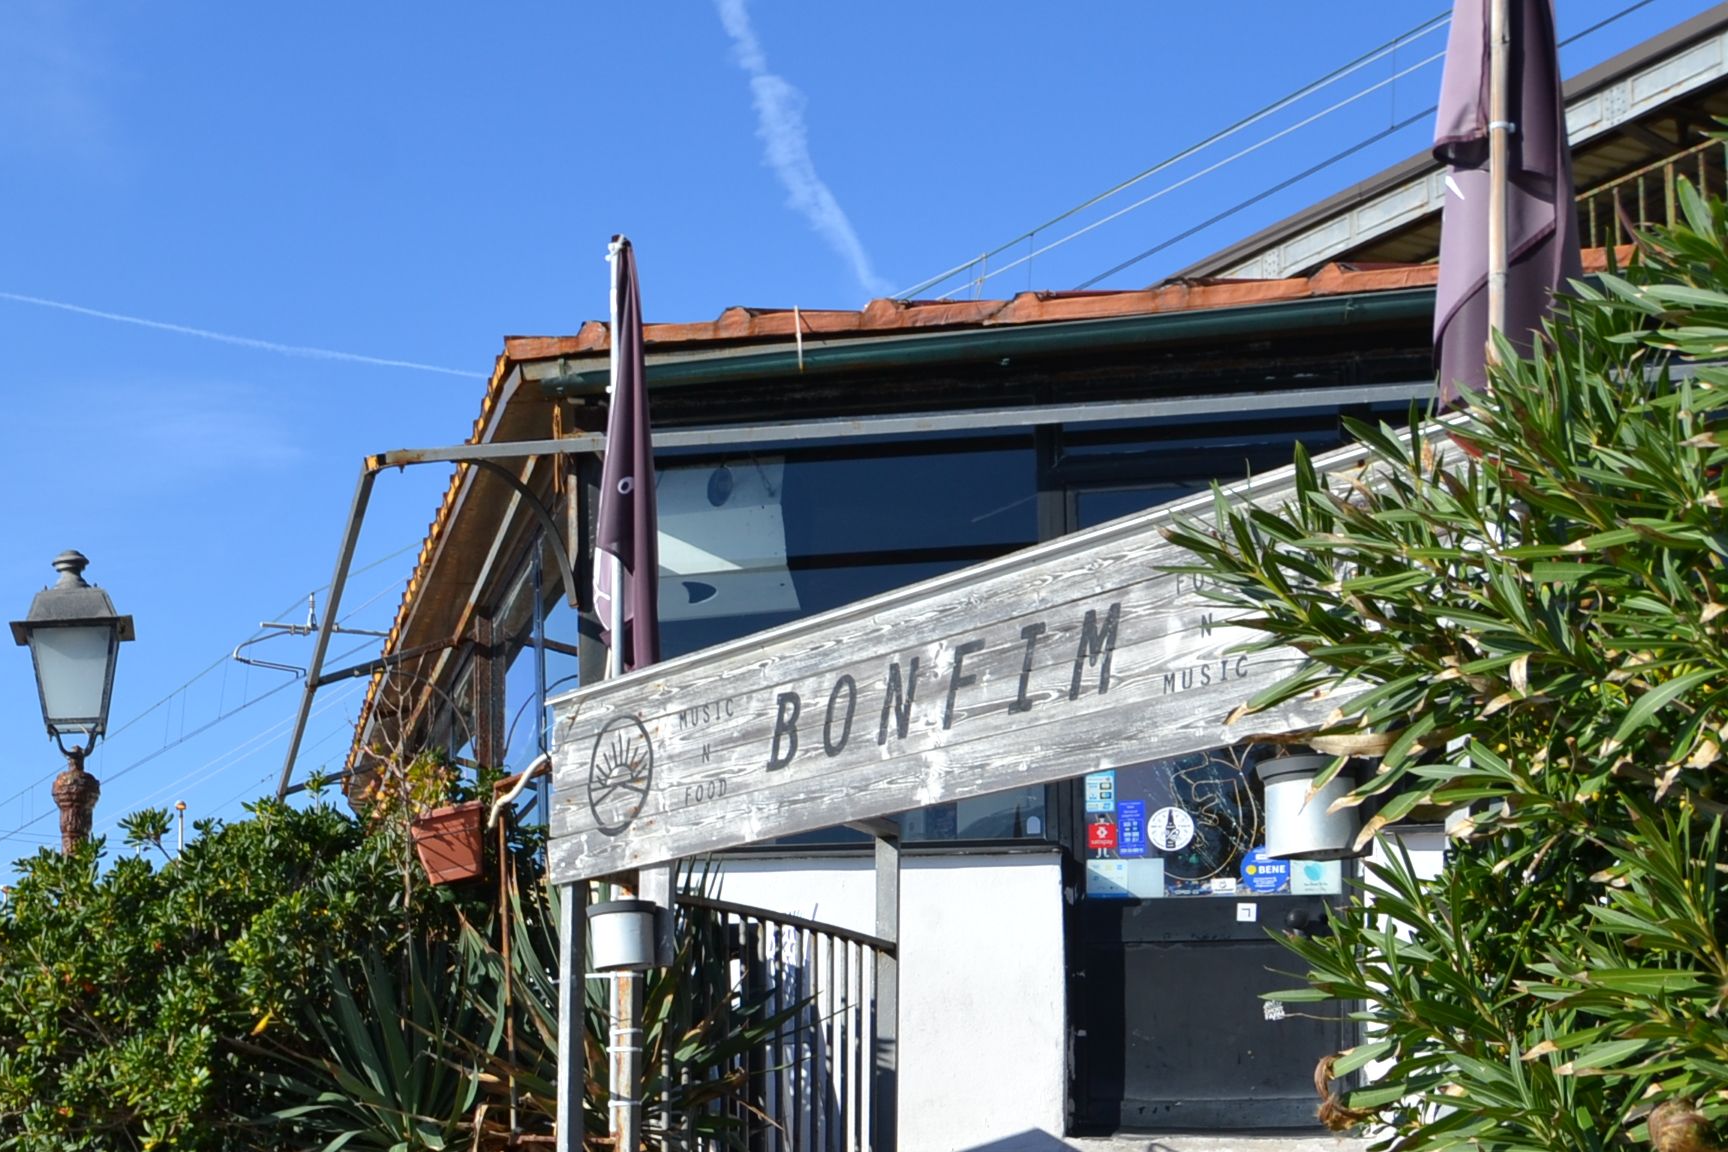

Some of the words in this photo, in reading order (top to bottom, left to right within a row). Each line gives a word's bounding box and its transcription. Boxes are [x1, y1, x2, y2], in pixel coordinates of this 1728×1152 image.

[1201, 613, 1212, 638] N
[766, 602, 1121, 772] BONFIM
[1163, 655, 1248, 694] MUSIC
[680, 699, 733, 730] MUSIC
[702, 744, 710, 763] N
[685, 777, 727, 807] FOOD
[1258, 864, 1286, 874] BENE
